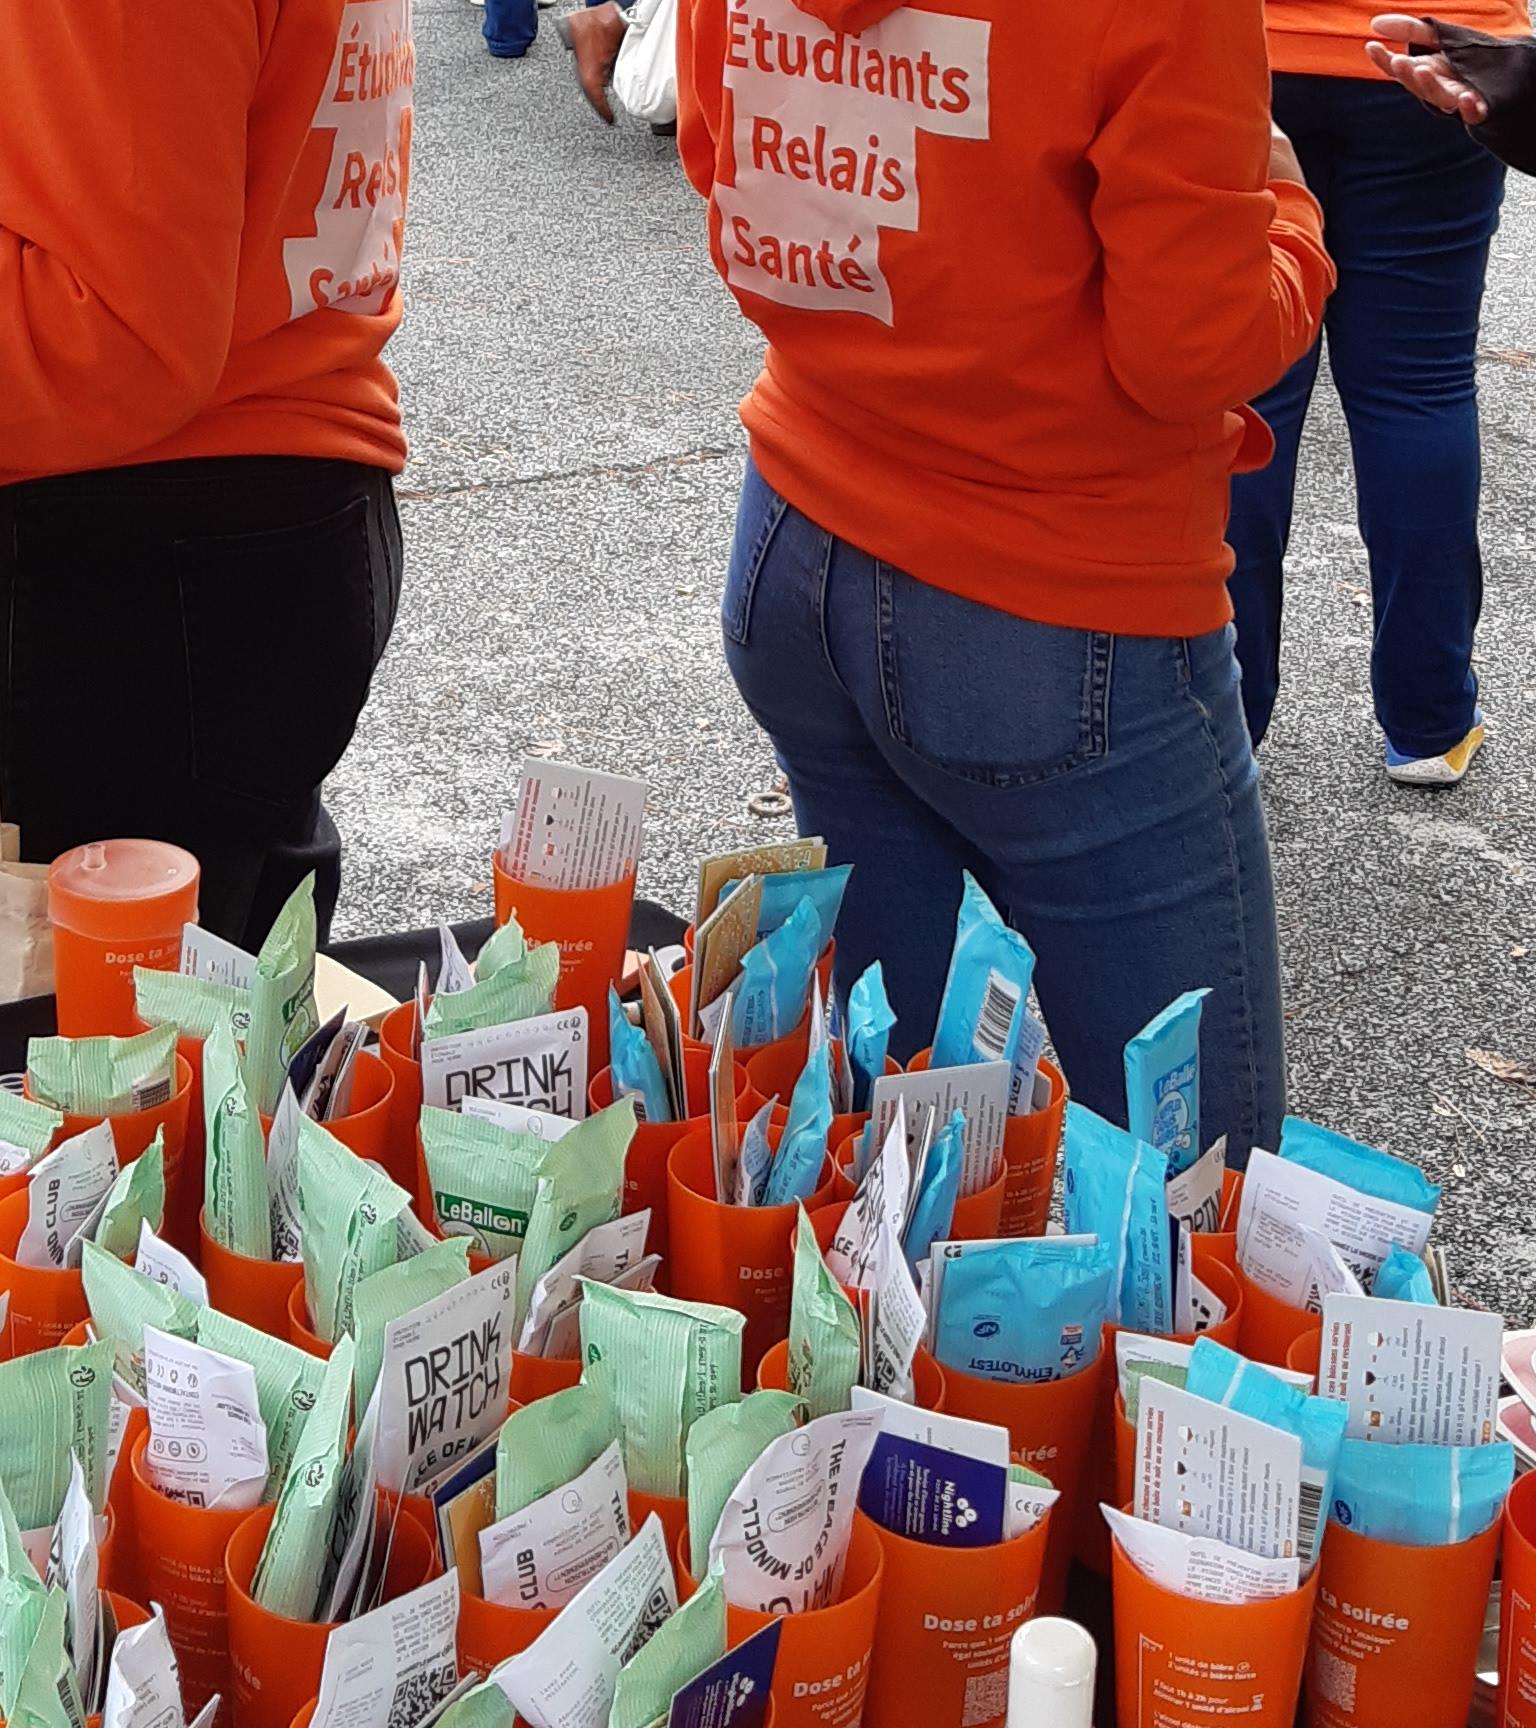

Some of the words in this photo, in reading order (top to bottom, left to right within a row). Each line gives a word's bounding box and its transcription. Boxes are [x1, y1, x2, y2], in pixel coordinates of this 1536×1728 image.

[752, 115, 906, 203] Relais
[732, 215, 875, 293] Santé
[105, 951, 144, 964] Dose
[558, 935, 593, 952] oirée
[445, 1050, 573, 1106] DRINK
[440, 1195, 523, 1234] LeBallon
[405, 1311, 501, 1407] DRINK
[968, 1358, 1054, 1378] ETHYLOTEST
[408, 1357, 500, 1455] WATCH
[827, 1438, 846, 1479] THE
[1011, 1443, 1058, 1462] oirée
[811, 1483, 838, 1560] PEACE
[941, 1479, 956, 1537] Nightline
[924, 1613, 977, 1632] Dose
[982, 1614, 1003, 1629] ta
[1342, 1602, 1410, 1631] soirée
[793, 1674, 841, 1698] Dose
